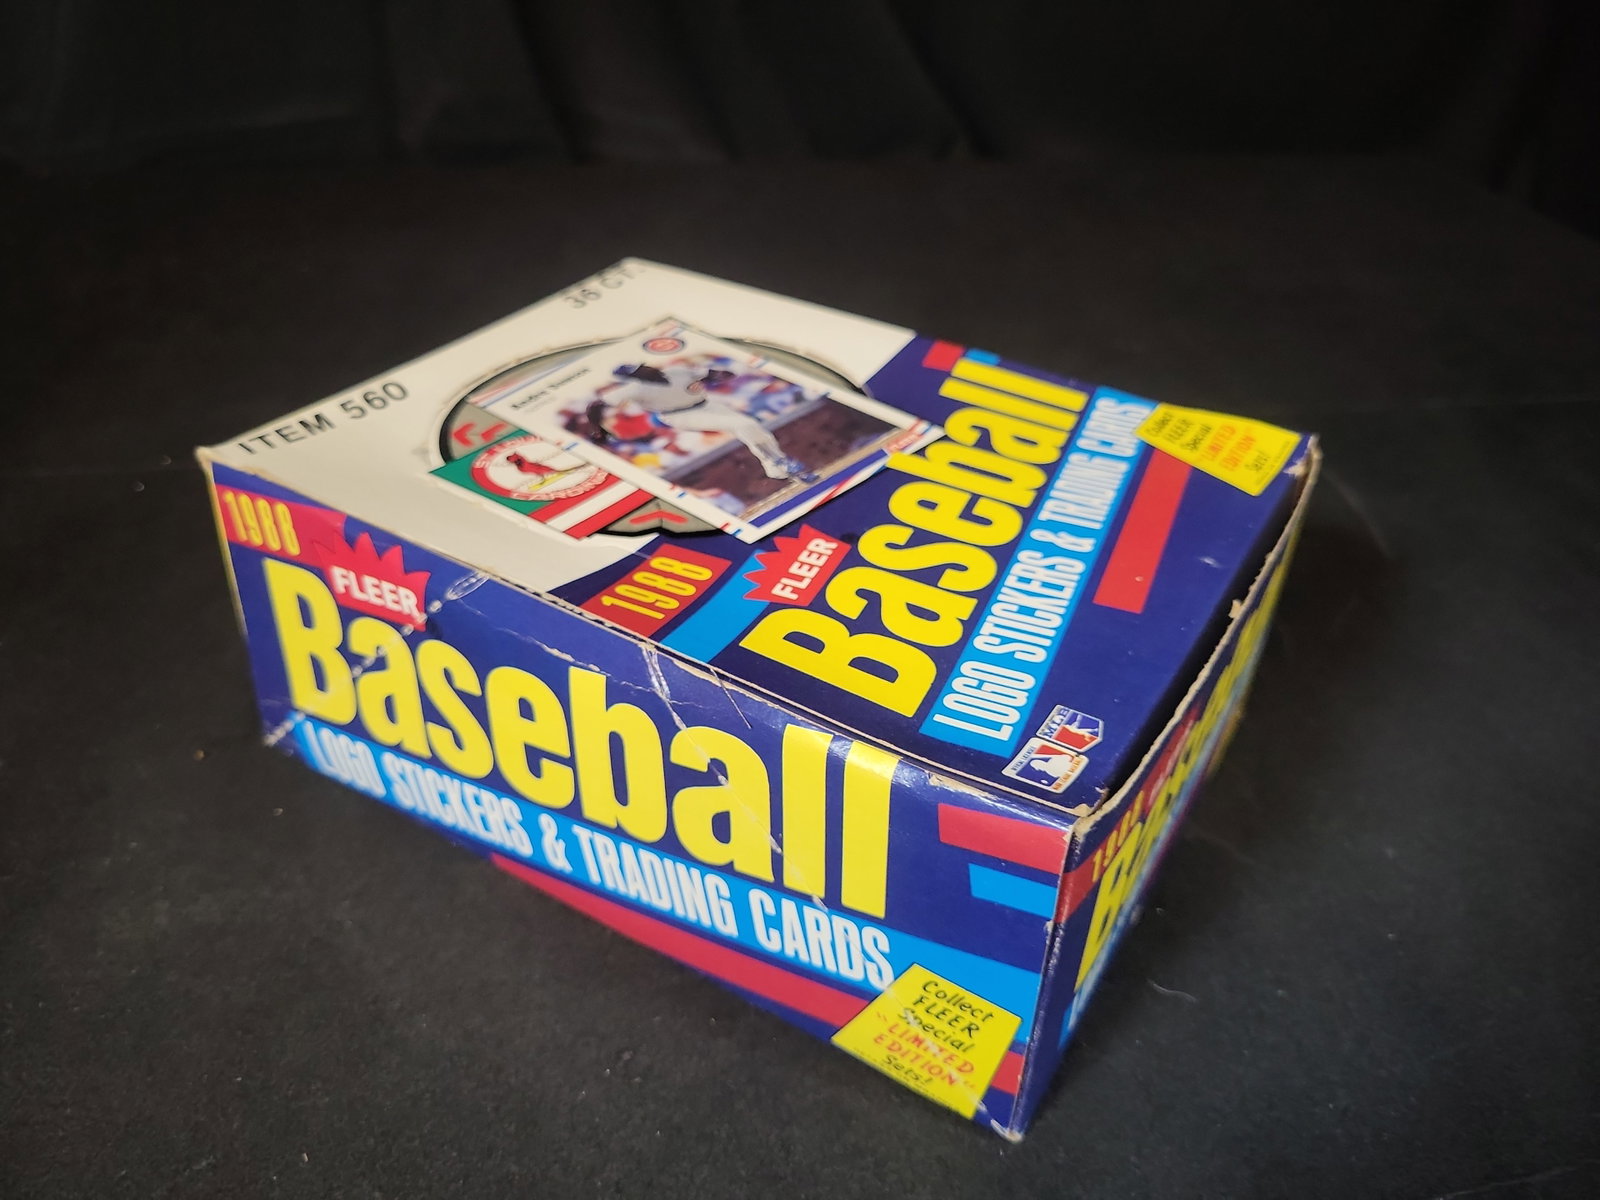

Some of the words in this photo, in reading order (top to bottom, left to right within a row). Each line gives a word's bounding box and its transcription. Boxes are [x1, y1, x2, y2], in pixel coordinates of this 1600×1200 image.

[238, 413, 336, 454] ITEM
[340, 382, 408, 419] 560
[222, 489, 301, 557] 1988
[1038, 452, 1132, 530] TRADING
[739, 356, 1090, 718] Baseball
[771, 536, 838, 600] FLEER
[1029, 527, 1097, 553] &
[330, 565, 420, 617] FLEER
[600, 555, 714, 621] 1988
[972, 549, 1087, 664] STICKERS
[933, 660, 1044, 742] LOGO
[262, 556, 901, 919] Baseball
[303, 720, 387, 799] LOGO
[382, 753, 534, 858] STICKERS
[538, 812, 573, 872] &
[572, 823, 739, 938] TRADING
[748, 887, 896, 993] CARDS
[898, 1007, 976, 1053] Special
[912, 995, 980, 1039] FLEER
[922, 979, 994, 1022] Collect
